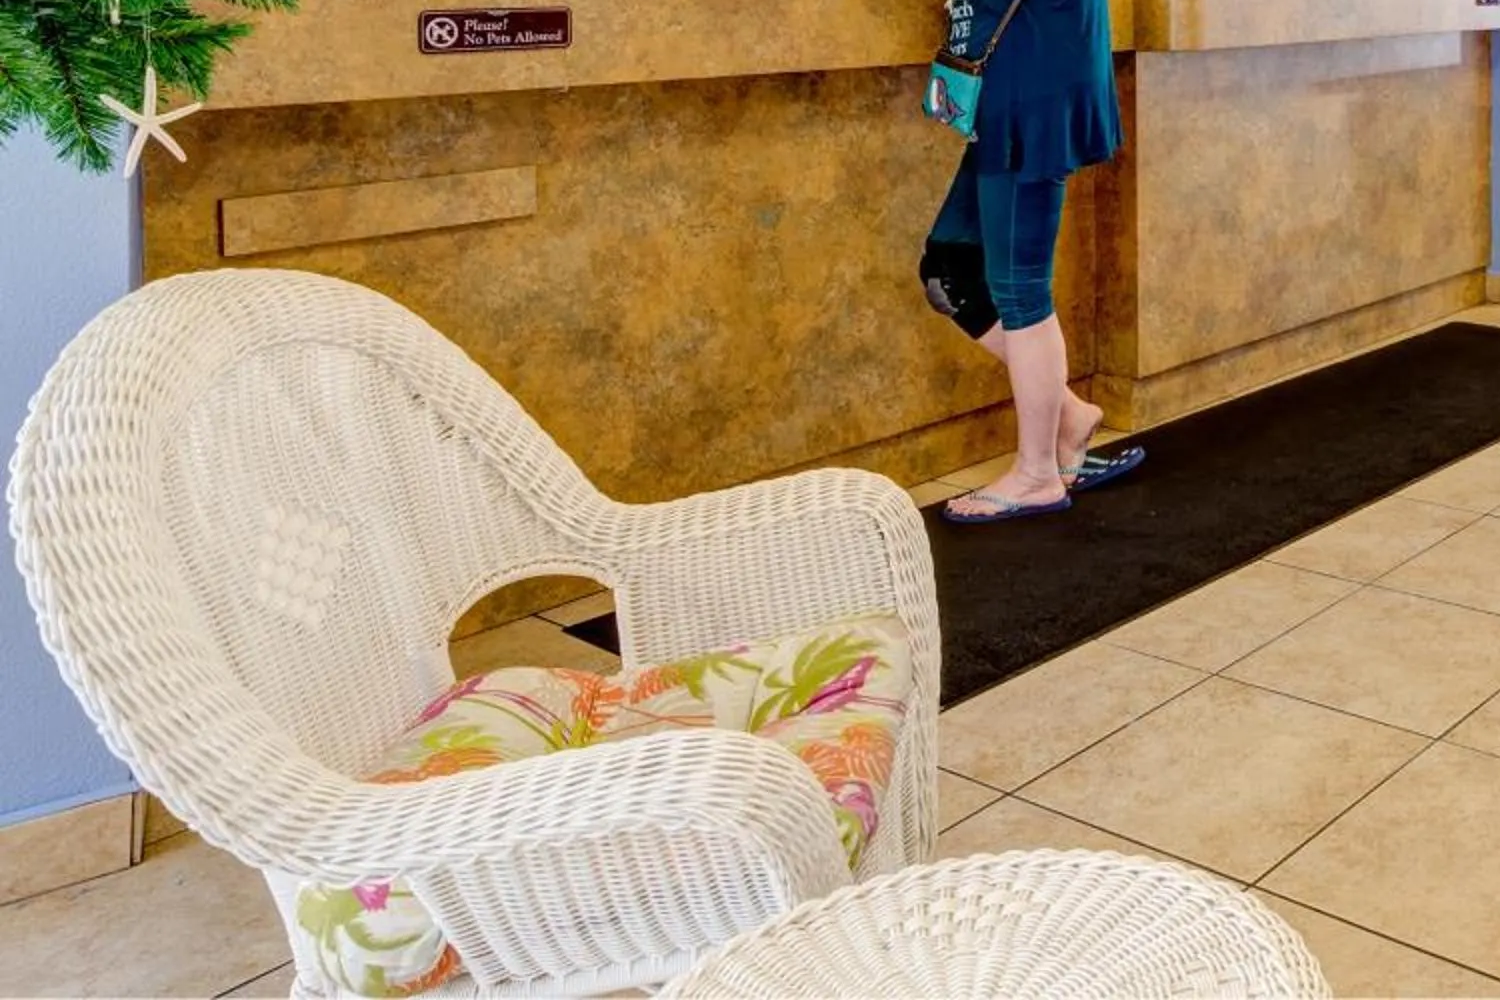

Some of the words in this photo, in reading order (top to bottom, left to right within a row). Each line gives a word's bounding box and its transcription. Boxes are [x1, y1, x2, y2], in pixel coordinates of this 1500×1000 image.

[463, 17, 509, 31] Please!
[463, 33, 484, 45] No
[487, 32, 511, 45] Pets
[515, 31, 563, 44] Allowed
